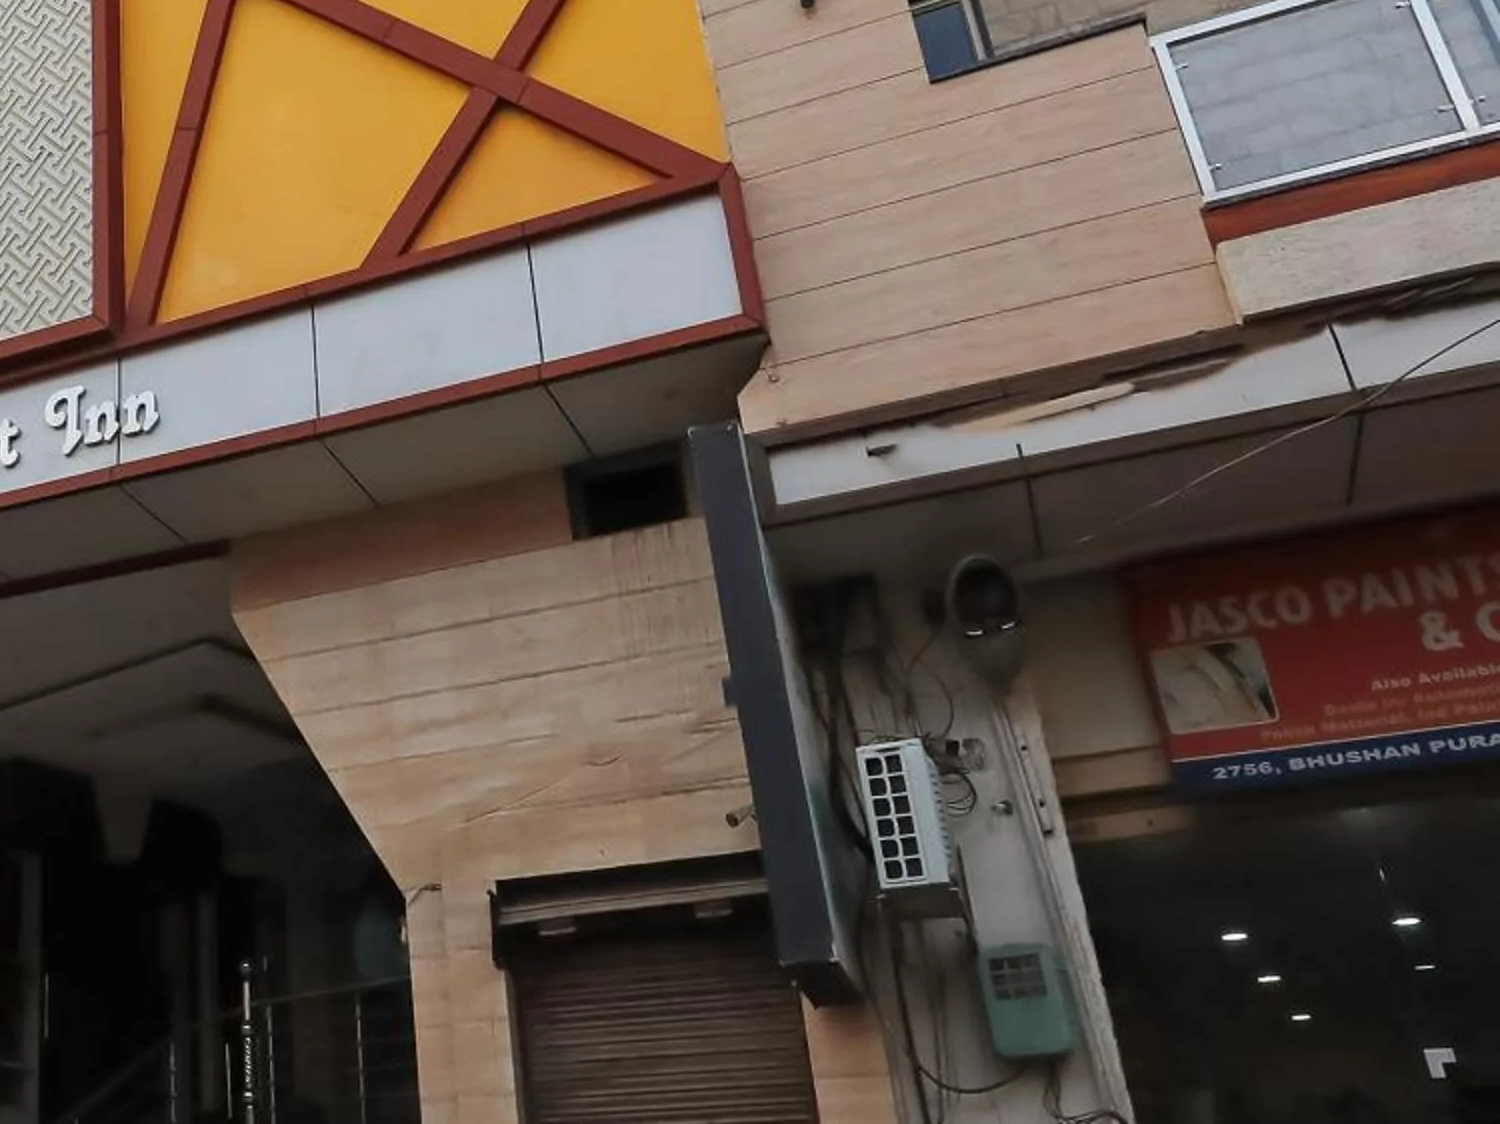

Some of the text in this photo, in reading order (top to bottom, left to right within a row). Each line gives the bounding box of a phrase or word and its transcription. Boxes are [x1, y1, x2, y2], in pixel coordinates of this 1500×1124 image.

[43, 384, 162, 457] Inn
[1167, 585, 1314, 643] JASCO
[1419, 611, 1464, 652] &
[1370, 676, 1412, 692] Also
[1212, 759, 1282, 780] 2756,
[1288, 741, 1421, 772] BHUSHAN
